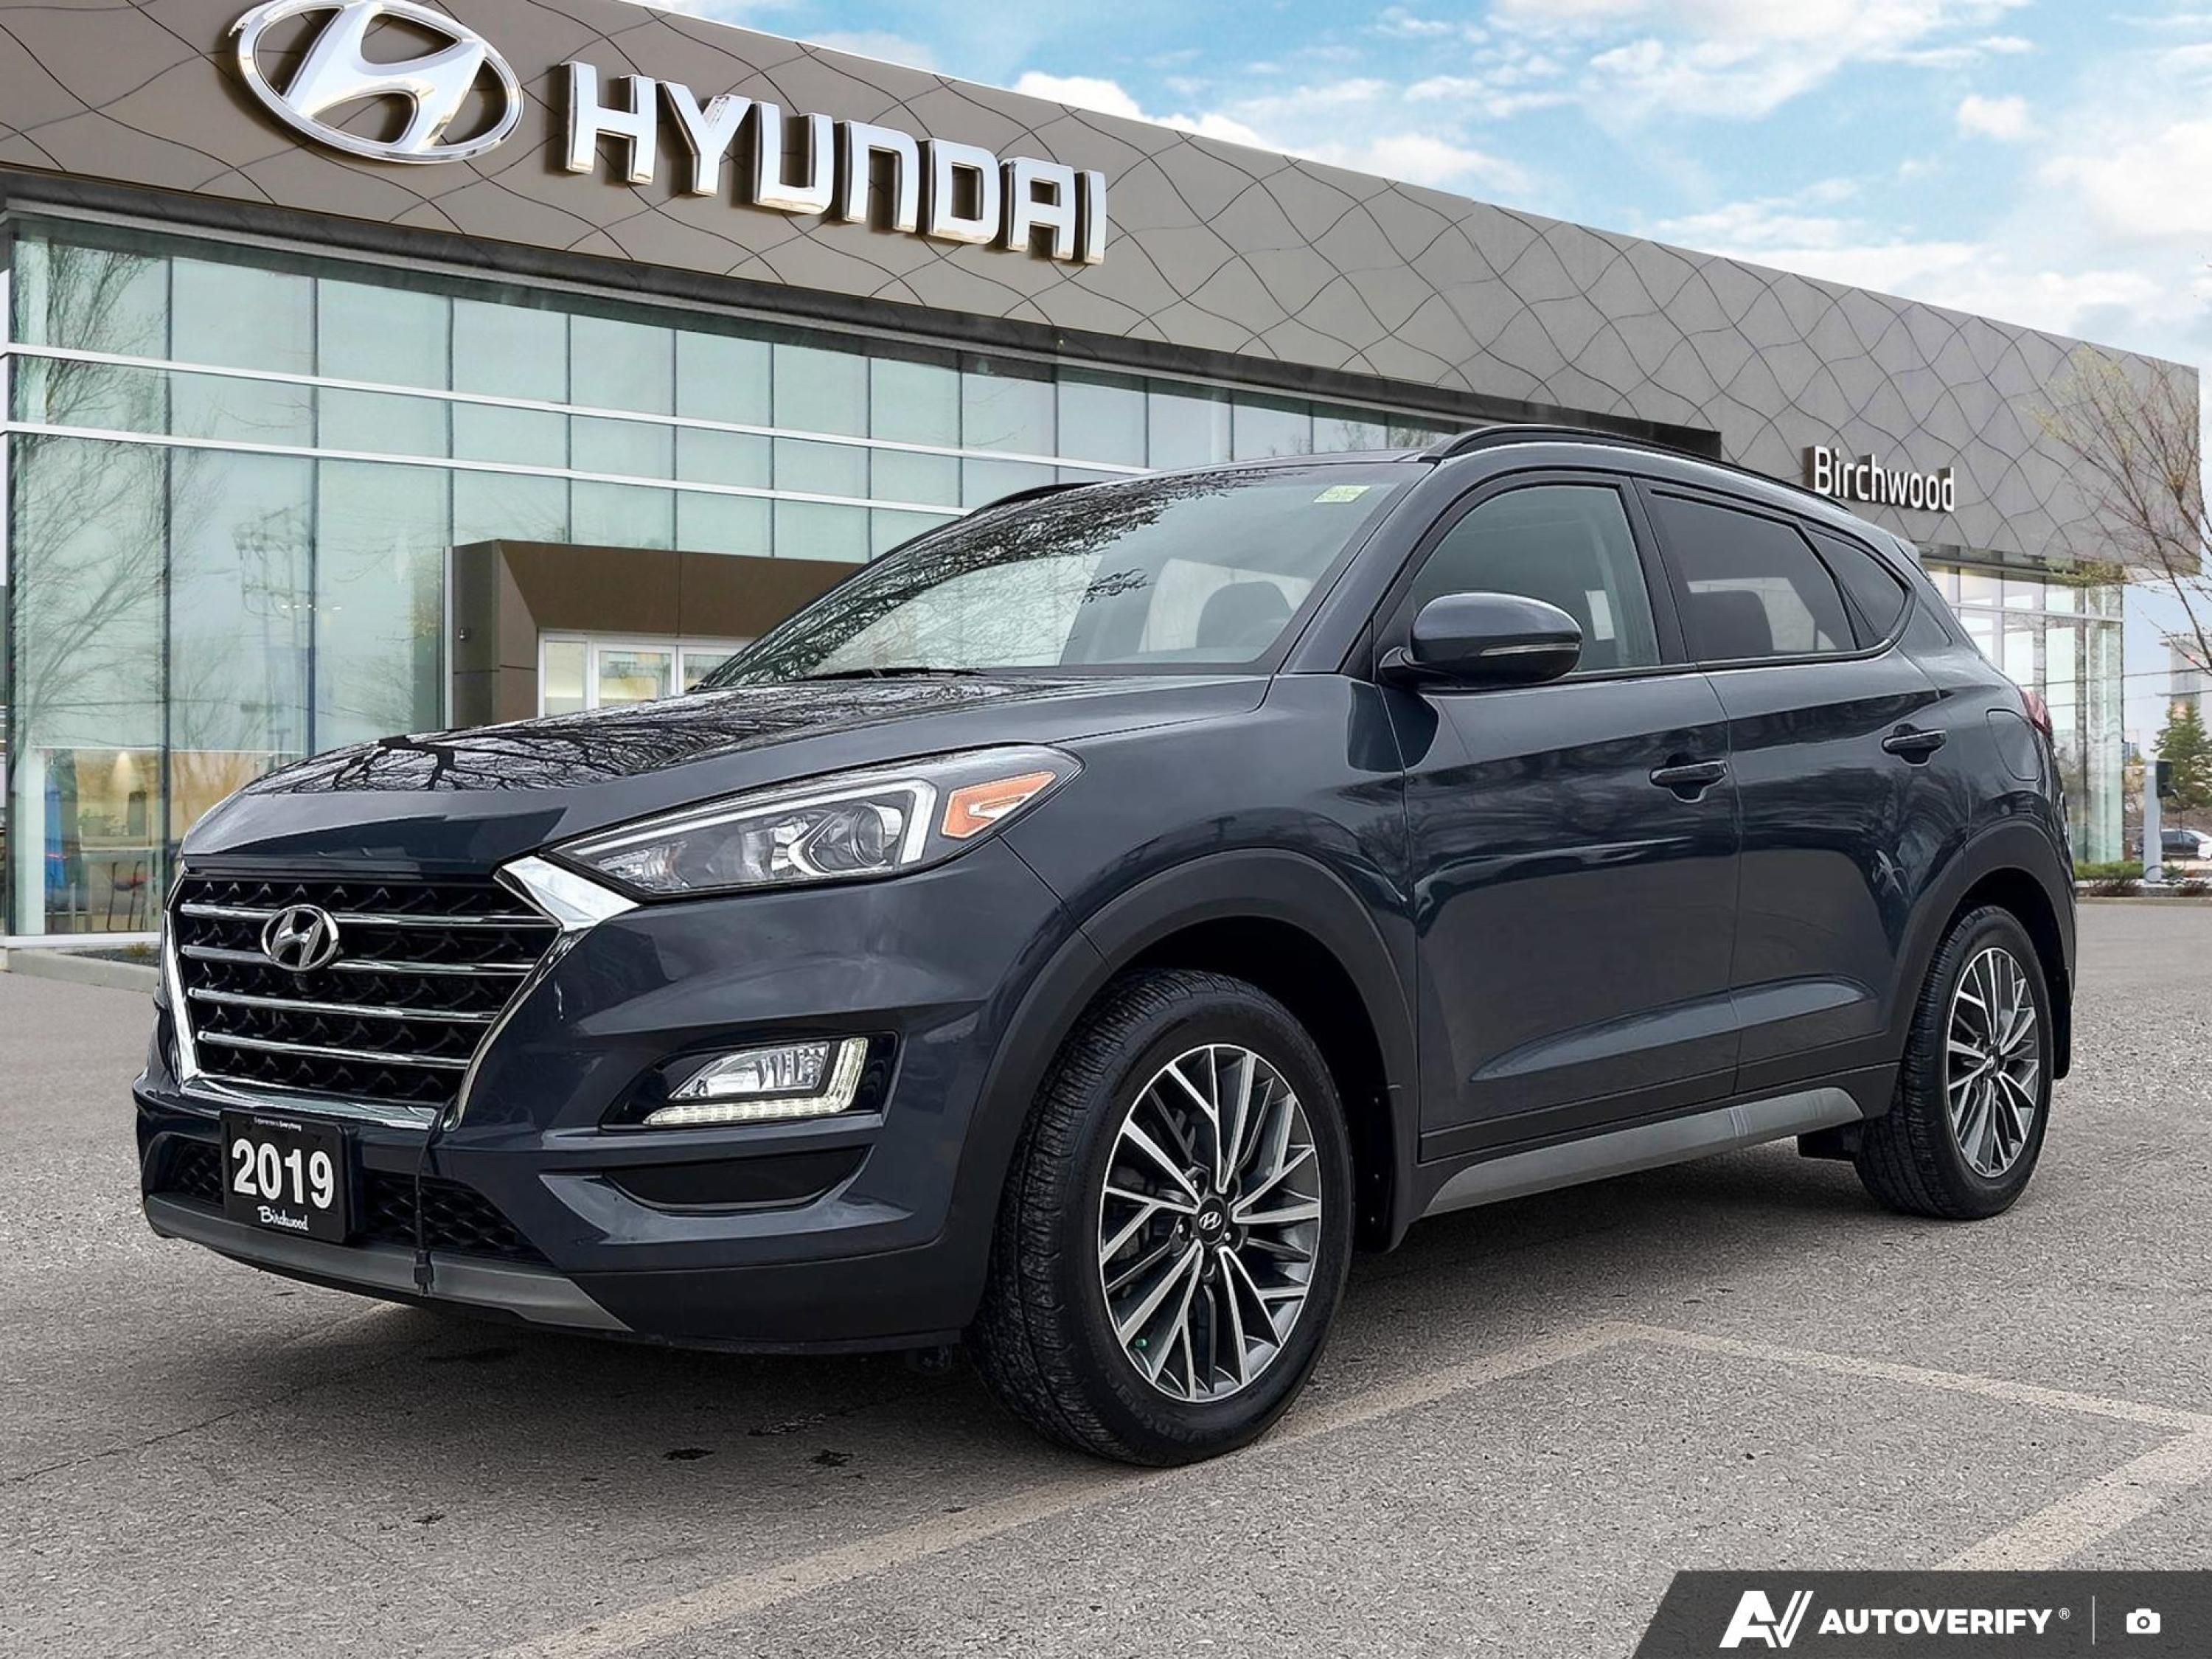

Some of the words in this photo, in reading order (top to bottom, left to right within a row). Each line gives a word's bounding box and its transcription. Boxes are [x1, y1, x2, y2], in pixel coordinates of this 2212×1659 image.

[562, 60, 1107, 265] HYUNDAI
[1812, 445, 1955, 512] Birchwood
[232, 1138, 334, 1209] 2019
